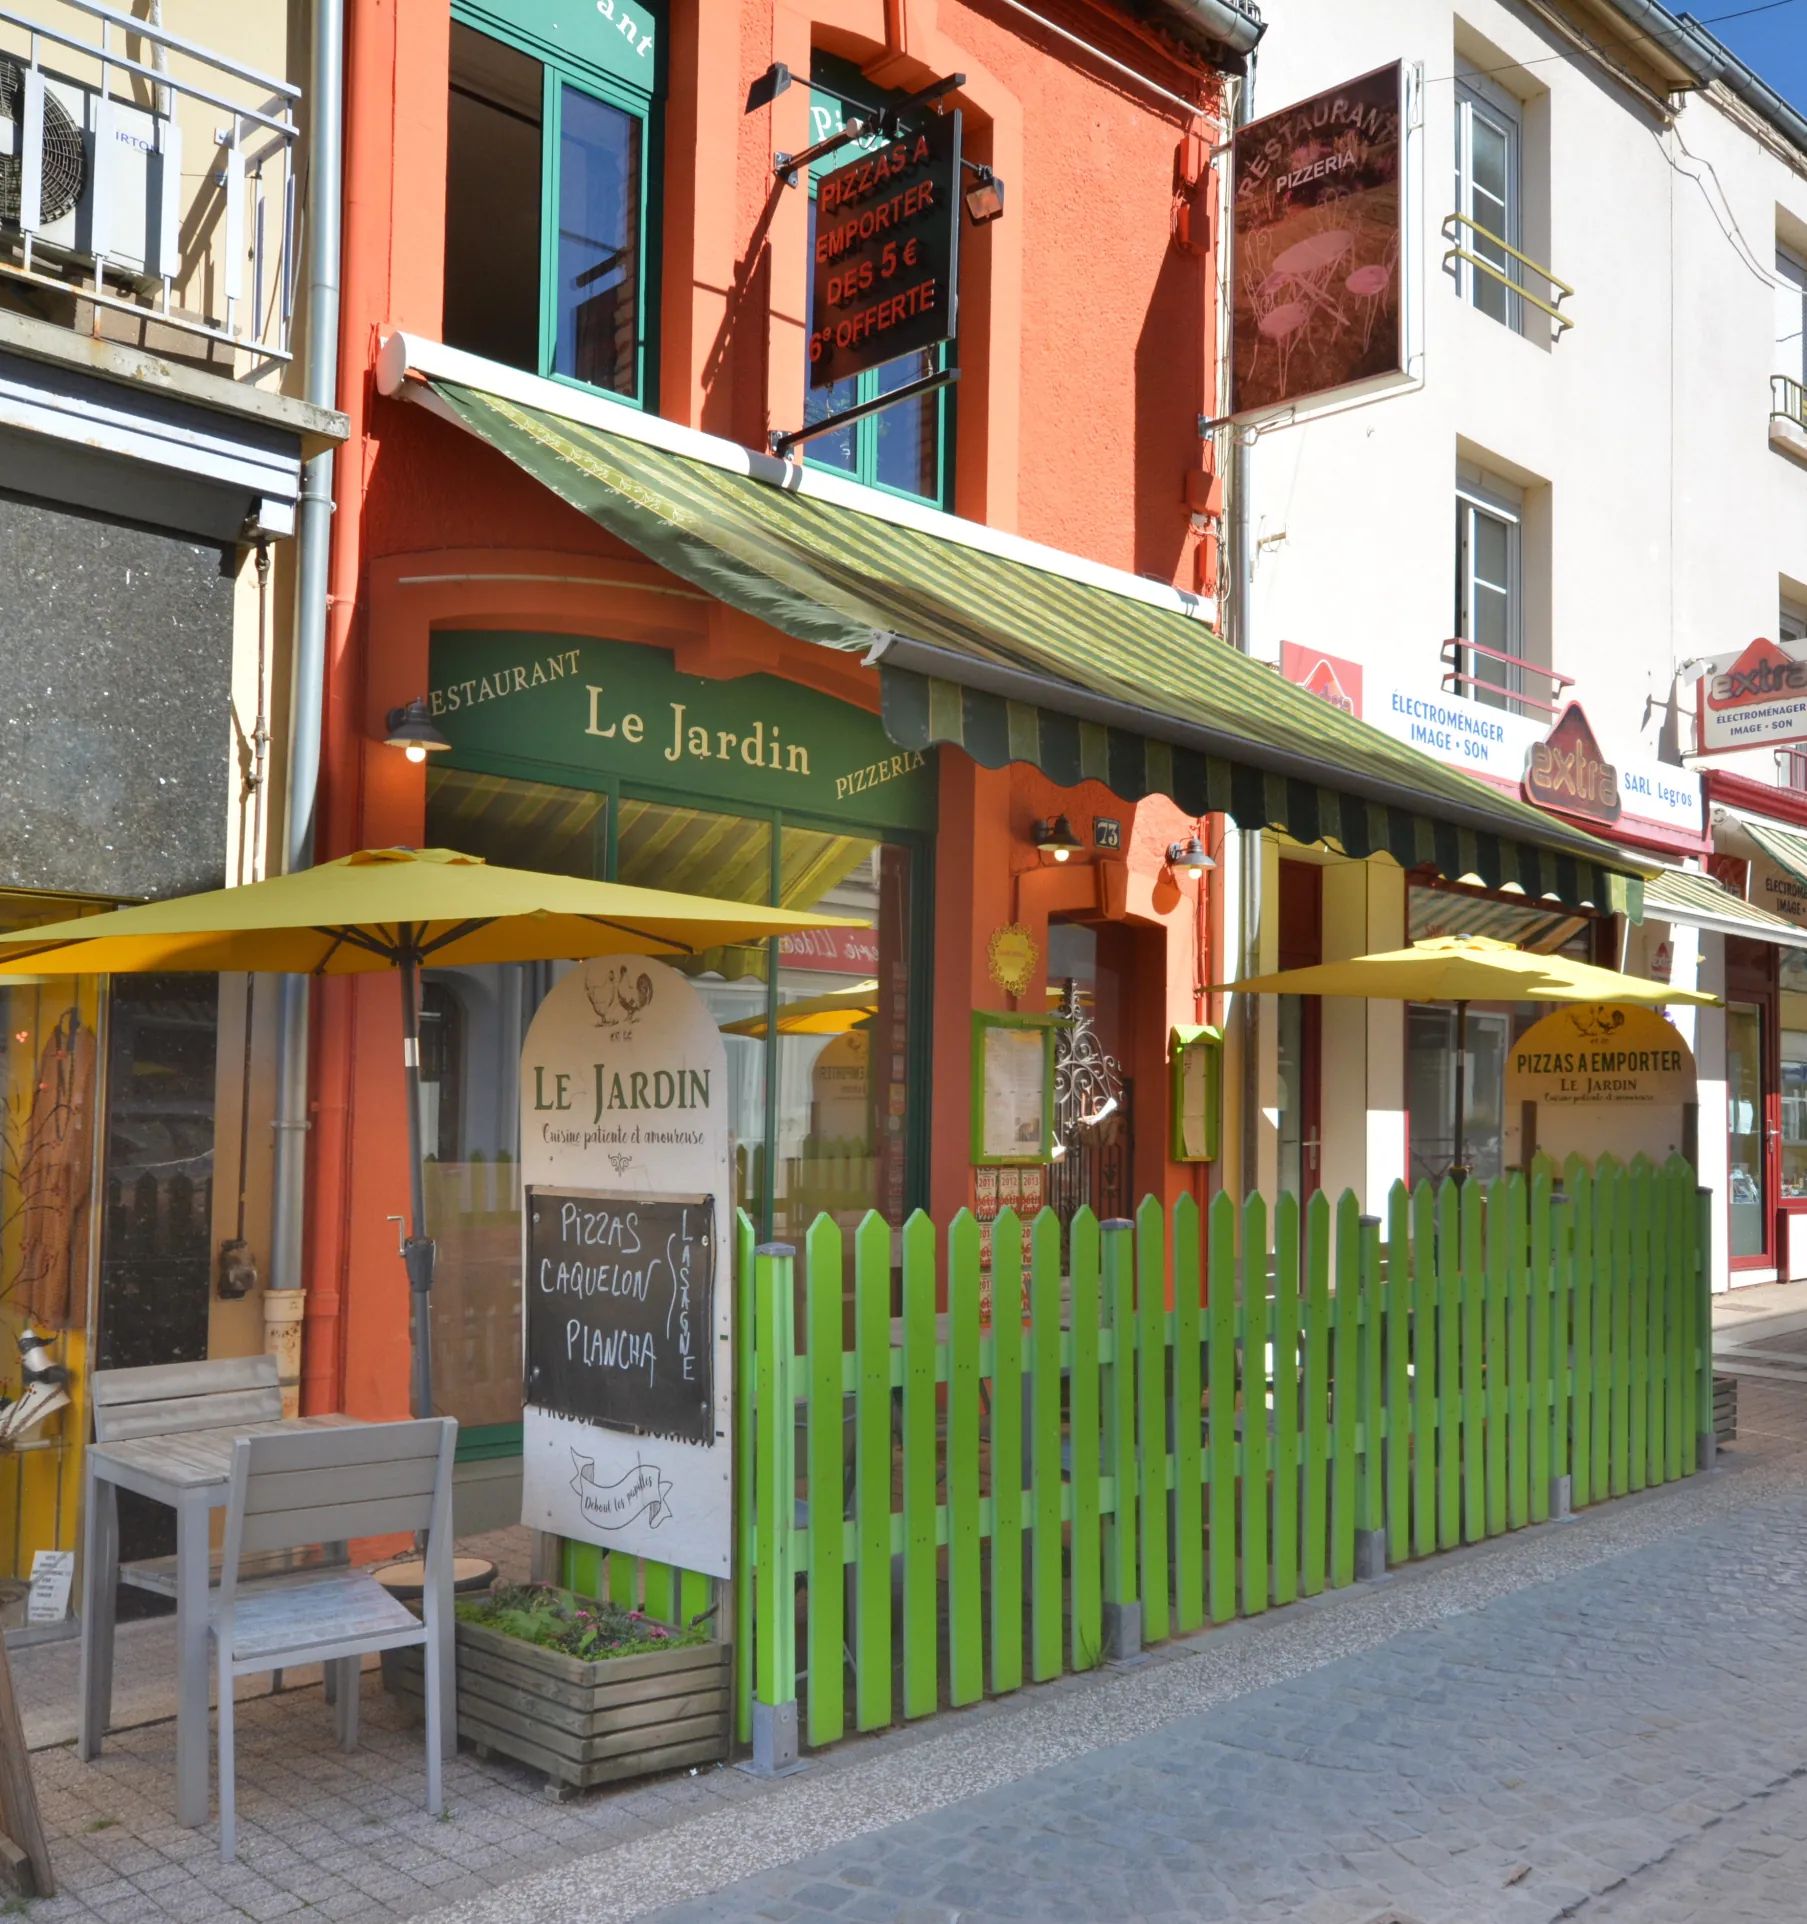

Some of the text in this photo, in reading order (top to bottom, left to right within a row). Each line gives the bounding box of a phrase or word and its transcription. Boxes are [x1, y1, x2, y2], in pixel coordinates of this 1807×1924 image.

[821, 135, 929, 212] PIZZAS A
[1238, 99, 1396, 199] RESTAURANT
[1276, 151, 1356, 192] PIZZERIA
[816, 180, 933, 263] EMPORTER
[827, 237, 917, 306] DES 5 €
[836, 278, 935, 347] OFFERTE
[430, 648, 580, 716] ESTAURANT
[1711, 658, 1807, 700] extra
[585, 684, 811, 775] Le Jardin
[1411, 723, 1488, 760] IMAGE SON
[1730, 719, 1793, 736] IMAGE SON
[835, 751, 926, 800] PIZZERIA
[1532, 742, 1618, 807] extra
[1624, 772, 1692, 807] SARL Legros
[1097, 822, 1118, 846] 73
[1517, 1050, 1682, 1073] PIZZAS A EMPORTER
[593, 1064, 711, 1124] JARDIN
[542, 1123, 704, 1150] Cuisine patiente et amoureuse
[540, 1258, 662, 1301] CAQUELON
[679, 1209, 696, 1381] LASAGNE
[567, 1319, 656, 1388] PLANCHA
